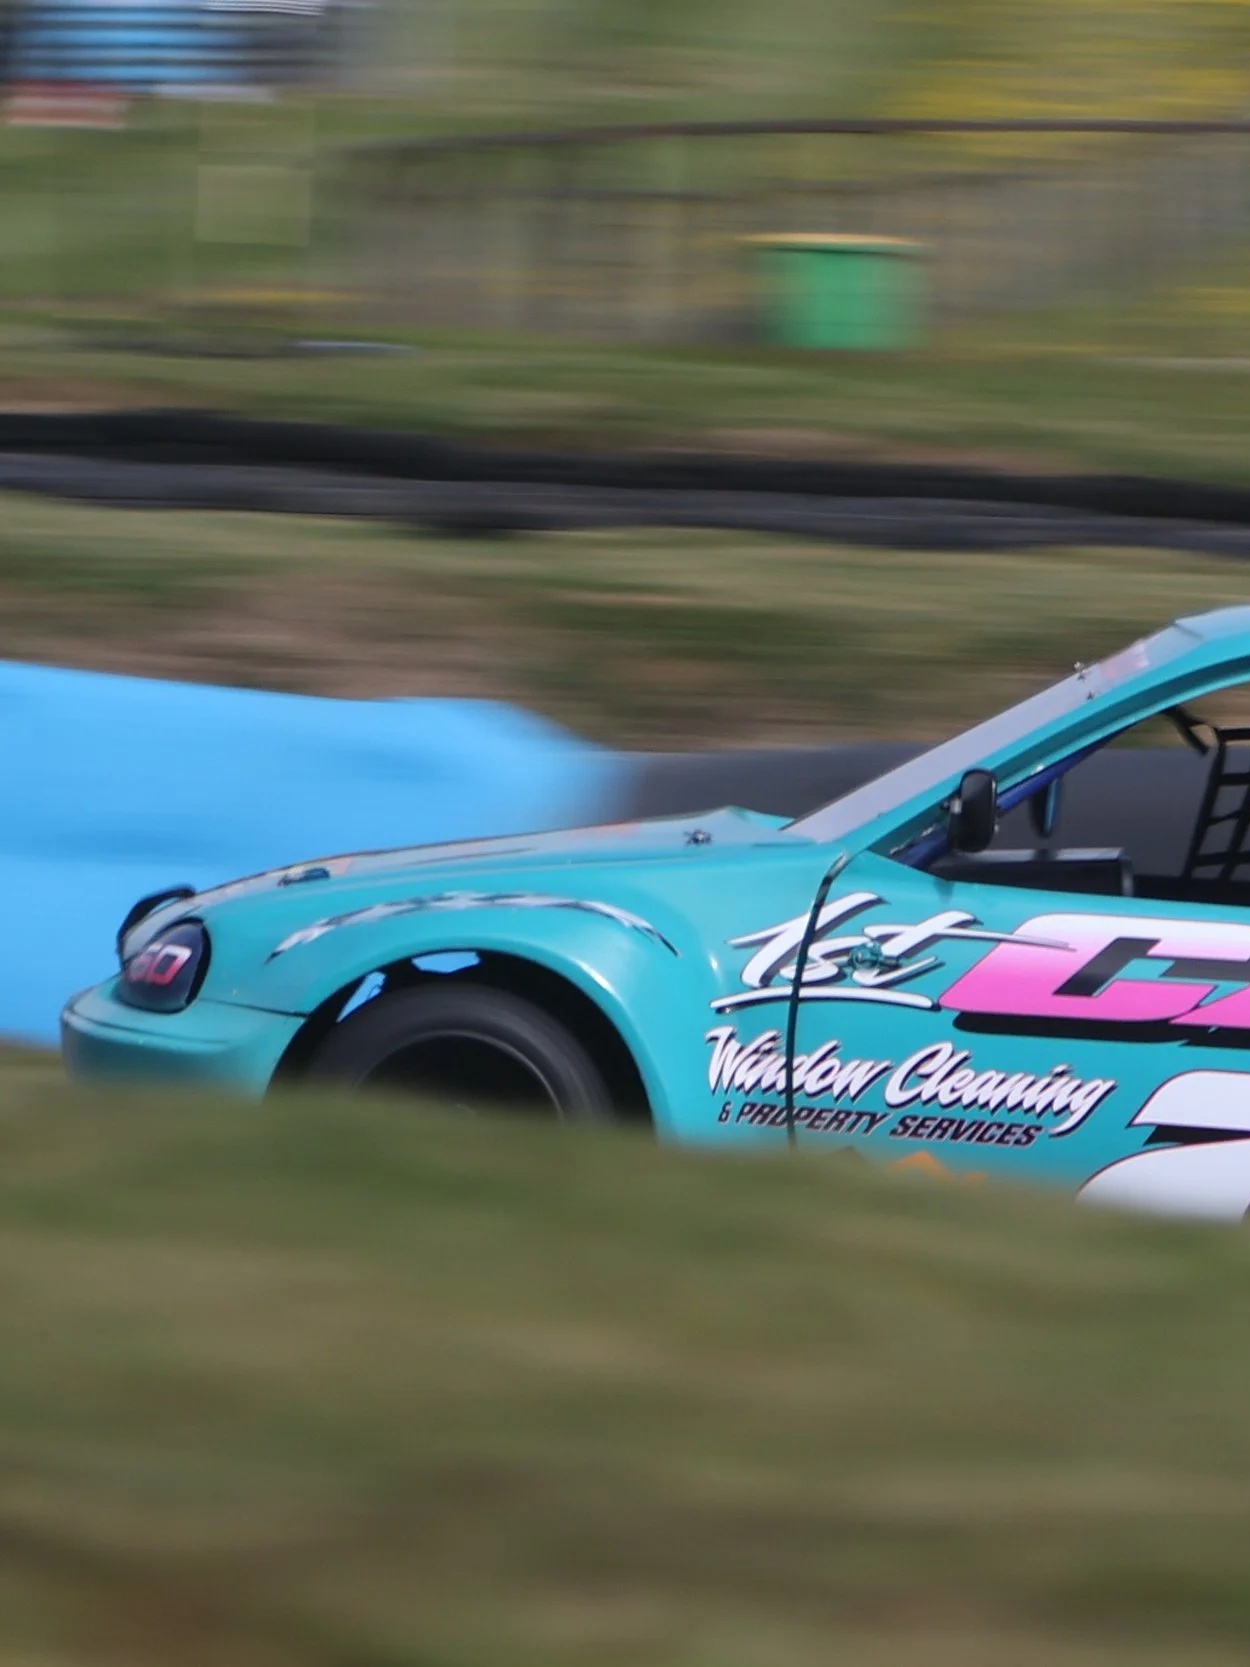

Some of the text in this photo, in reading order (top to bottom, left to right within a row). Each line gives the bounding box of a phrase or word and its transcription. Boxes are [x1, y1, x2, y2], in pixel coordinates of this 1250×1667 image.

[727, 891, 1072, 992] 1st
[705, 1025, 1117, 1137] Window Cleaning
[735, 1101, 891, 1136] PROPERTY
[888, 1113, 1045, 1147] SERVICES
